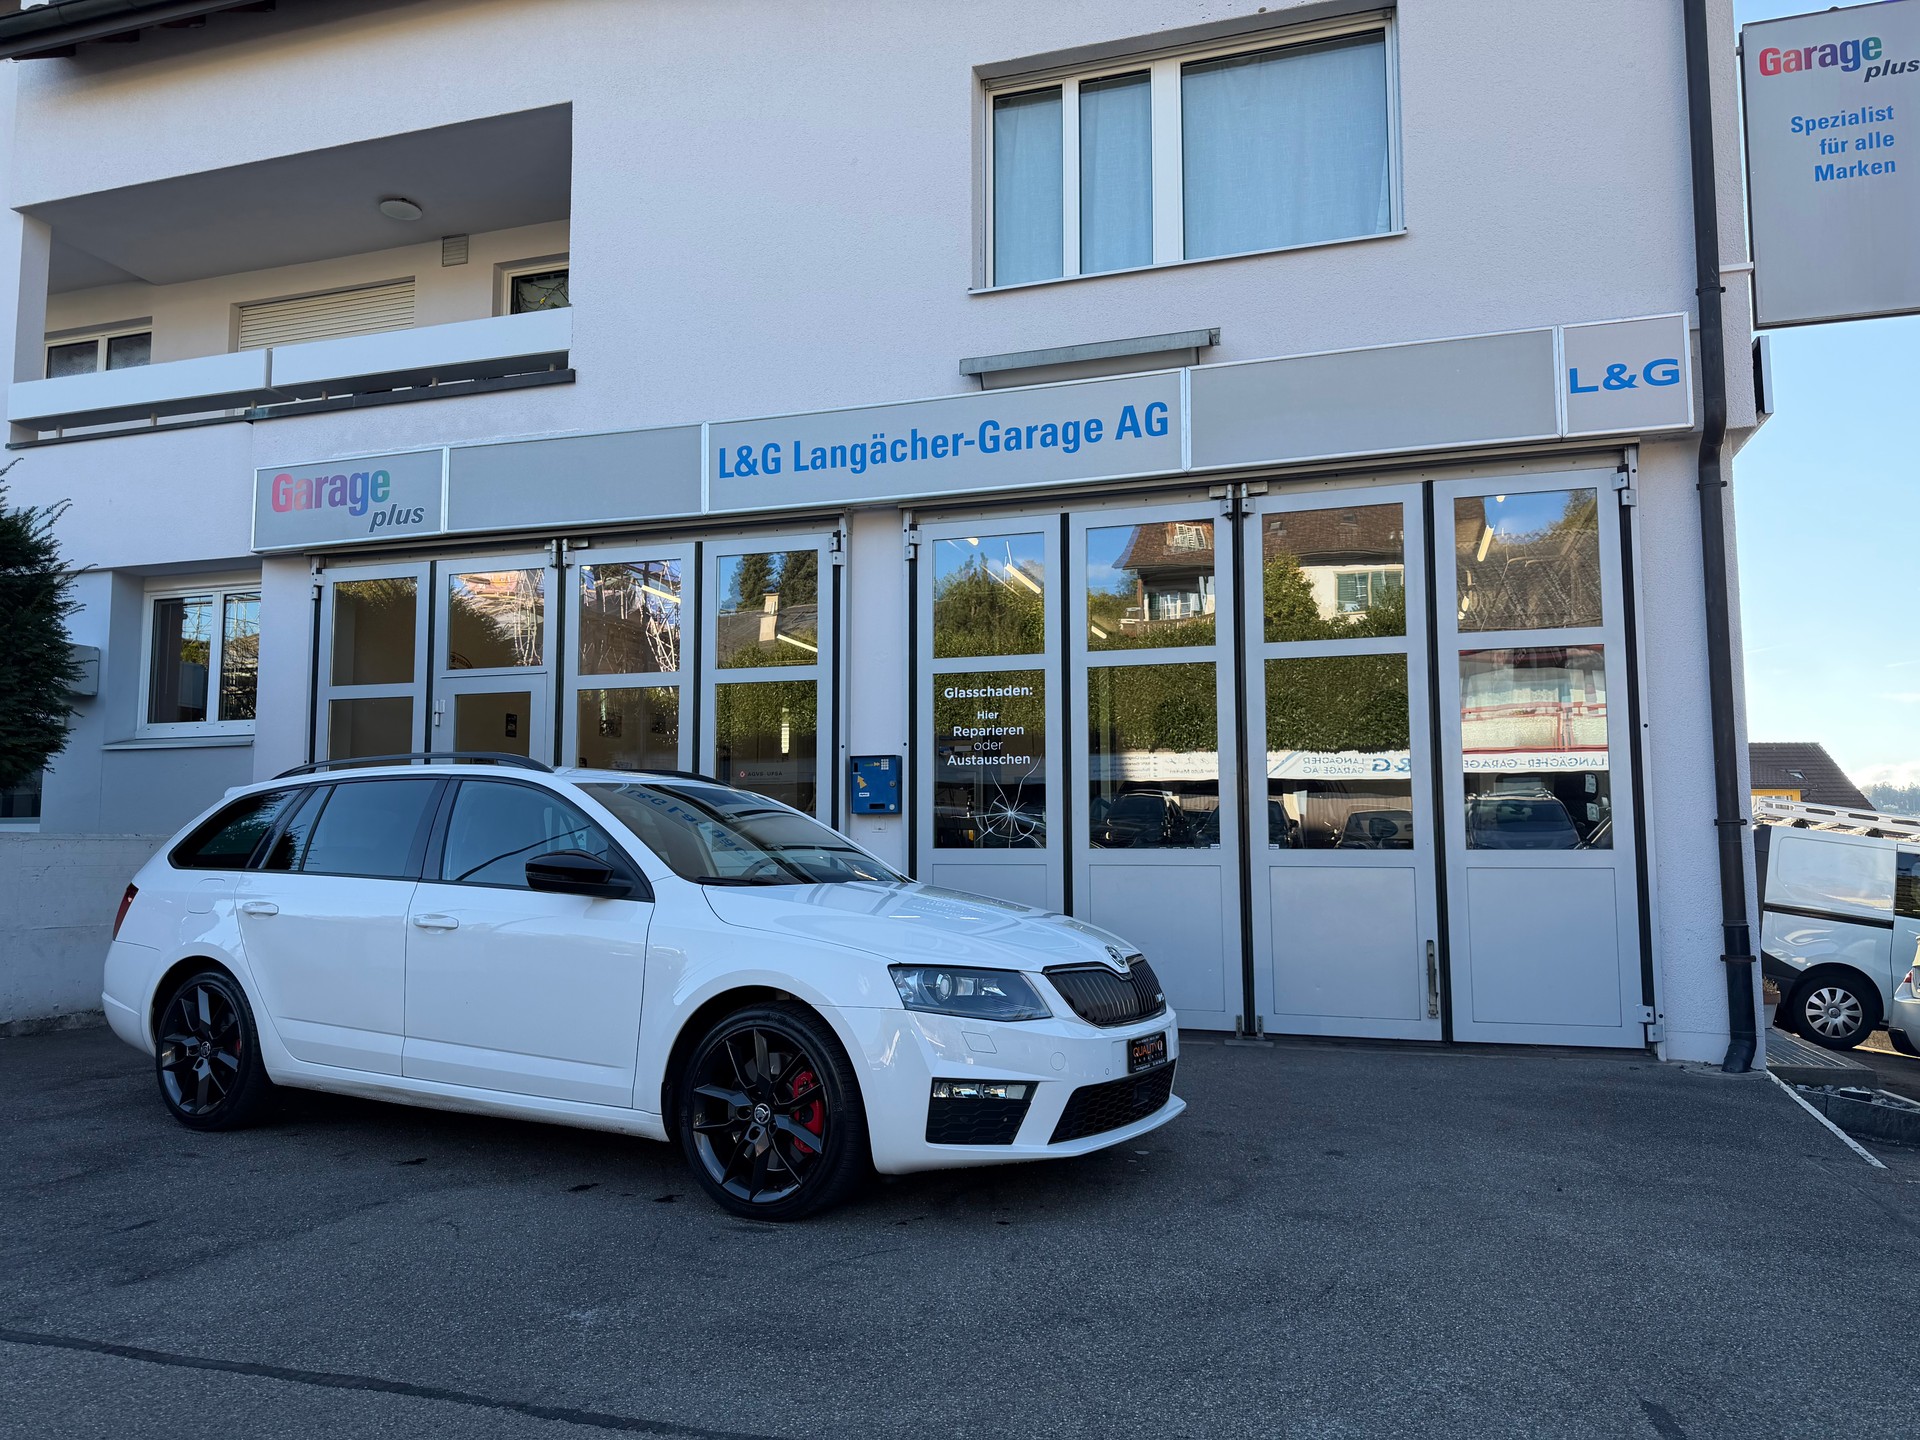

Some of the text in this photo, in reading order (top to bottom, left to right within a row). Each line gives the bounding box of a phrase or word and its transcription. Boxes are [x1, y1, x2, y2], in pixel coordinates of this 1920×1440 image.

[1759, 36, 1883, 77] Garage
[1863, 59, 1920, 83] plus
[1790, 105, 1895, 136] Spezialist
[1819, 132, 1895, 155] für alle
[1814, 159, 1896, 182] Marken
[1569, 358, 1680, 394] L&G
[719, 401, 1169, 479] L&G Langächer-Garage AG
[272, 469, 390, 516] Garage
[369, 503, 425, 533] plus
[944, 685, 1033, 699] Glasschaden:
[977, 710, 999, 720] Hier
[953, 725, 1024, 738] Reparieren
[974, 740, 1004, 751] oder
[947, 754, 1031, 766] Austauschen
